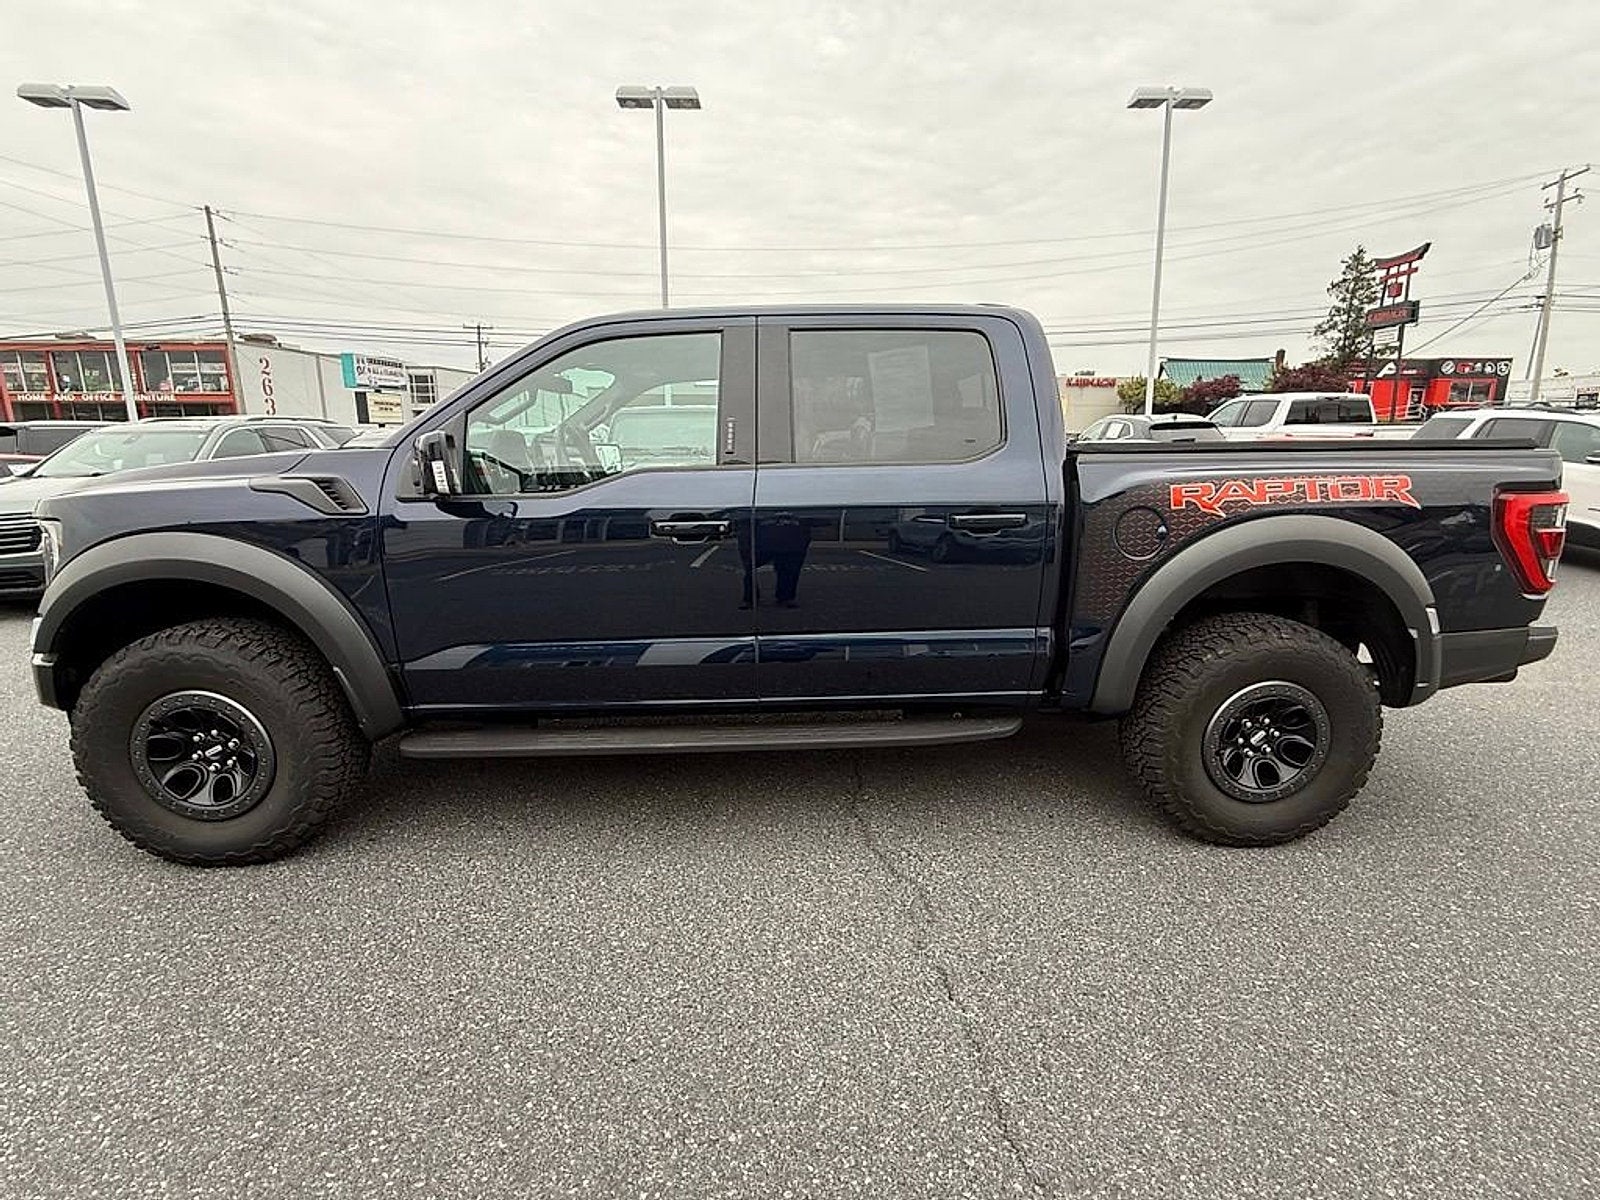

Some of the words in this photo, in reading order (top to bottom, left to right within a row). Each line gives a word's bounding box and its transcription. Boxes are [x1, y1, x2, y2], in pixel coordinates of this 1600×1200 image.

[17, 393, 46, 402] HOME
[54, 393, 75, 402] AND
[82, 393, 116, 402] OFFICE
[121, 393, 177, 402] FRNITURE
[259, 357, 276, 416] 263
[1170, 474, 1421, 517] RAPTOR
